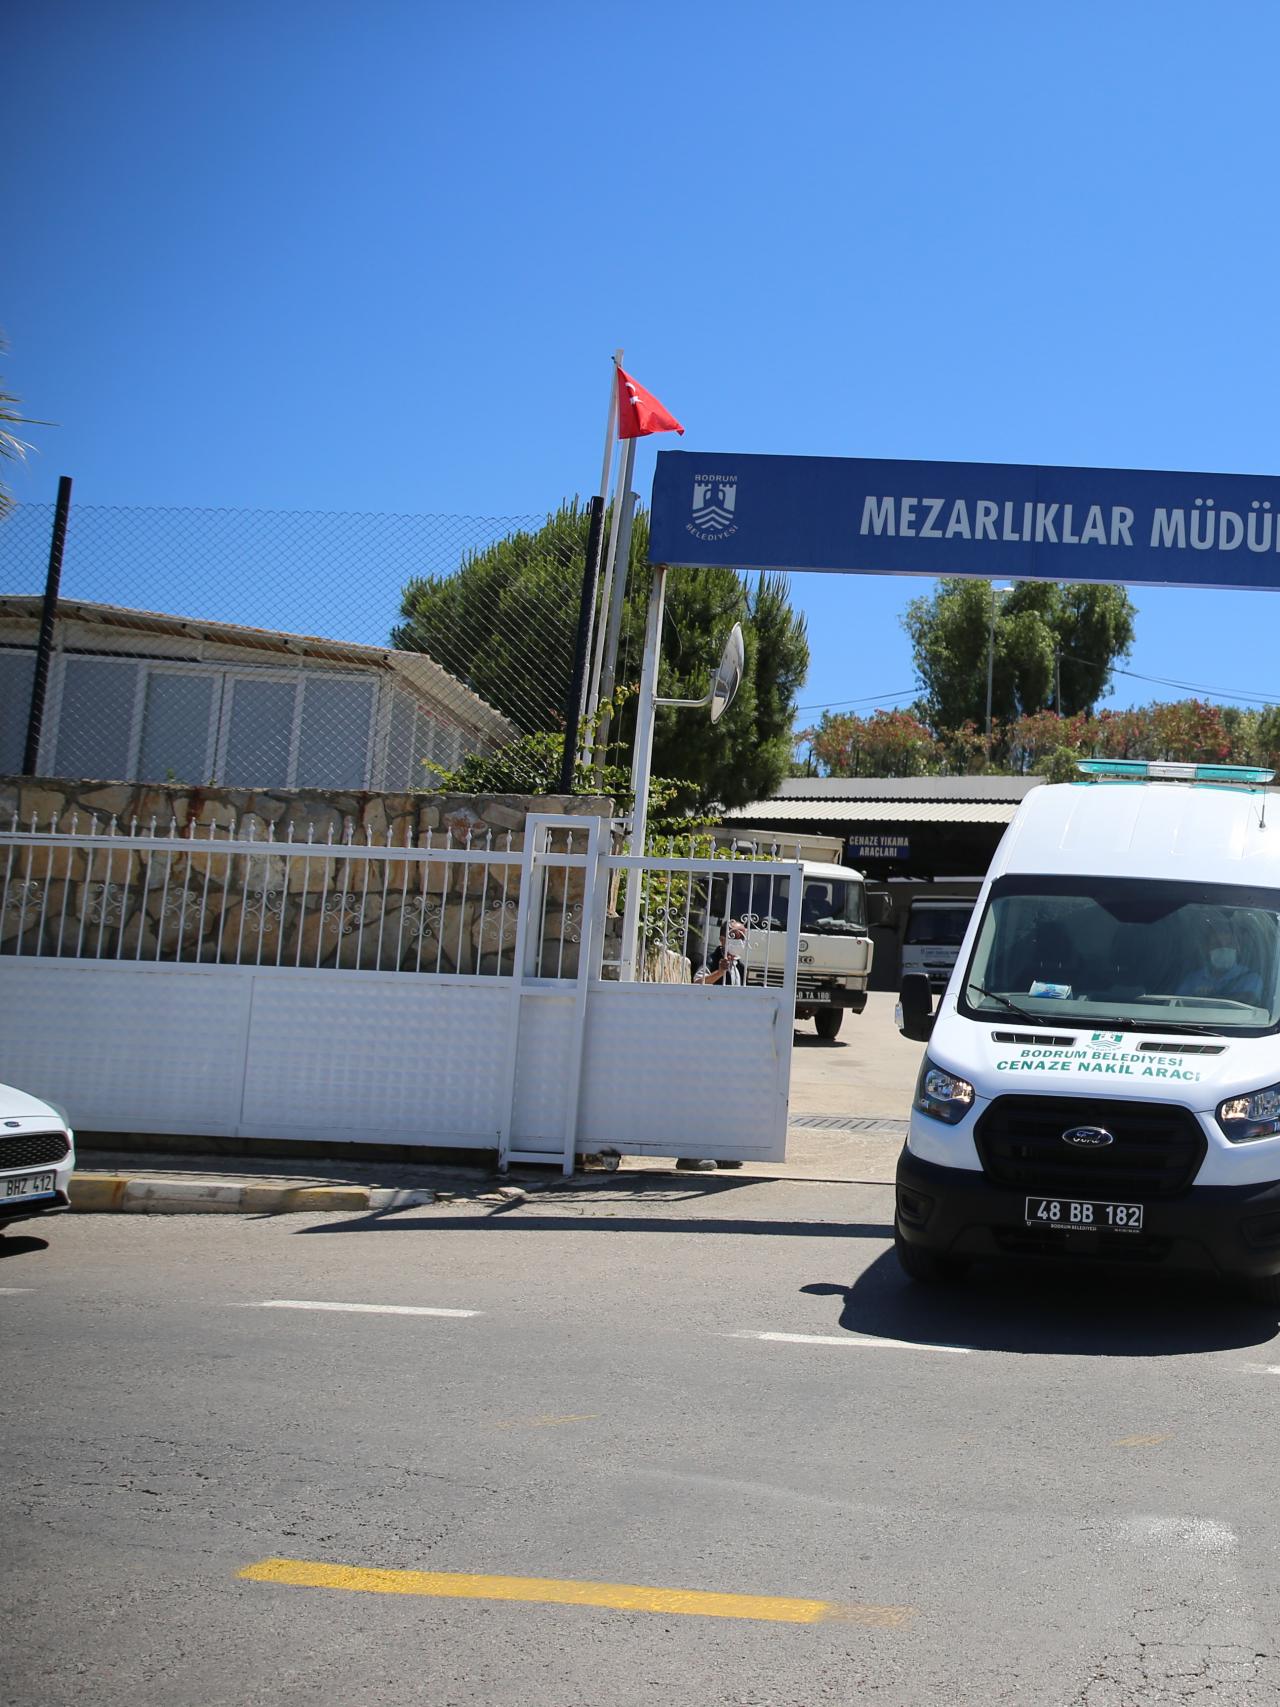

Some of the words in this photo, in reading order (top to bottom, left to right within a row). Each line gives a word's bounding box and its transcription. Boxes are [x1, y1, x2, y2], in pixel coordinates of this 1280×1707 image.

[694, 474, 738, 482] BODRUM
[859, 495, 1135, 546] MEZARLIKLAR
[849, 836, 878, 846] CENAZE
[880, 836, 909, 847] YIKAMA
[859, 847, 898, 858] ARAÇLARI
[1020, 1049, 1087, 1059] BODRUM
[1091, 1051, 1183, 1067] BELEDİYESİ
[996, 1060, 1072, 1071] CENAZE
[1077, 1061, 1134, 1075] NAKİL
[6, 1178, 28, 1197] BHZ
[33, 1175, 52, 1192] 412
[1037, 1201, 1061, 1221] 48
[1070, 1203, 1094, 1224] BB
[1106, 1205, 1140, 1227] 182
